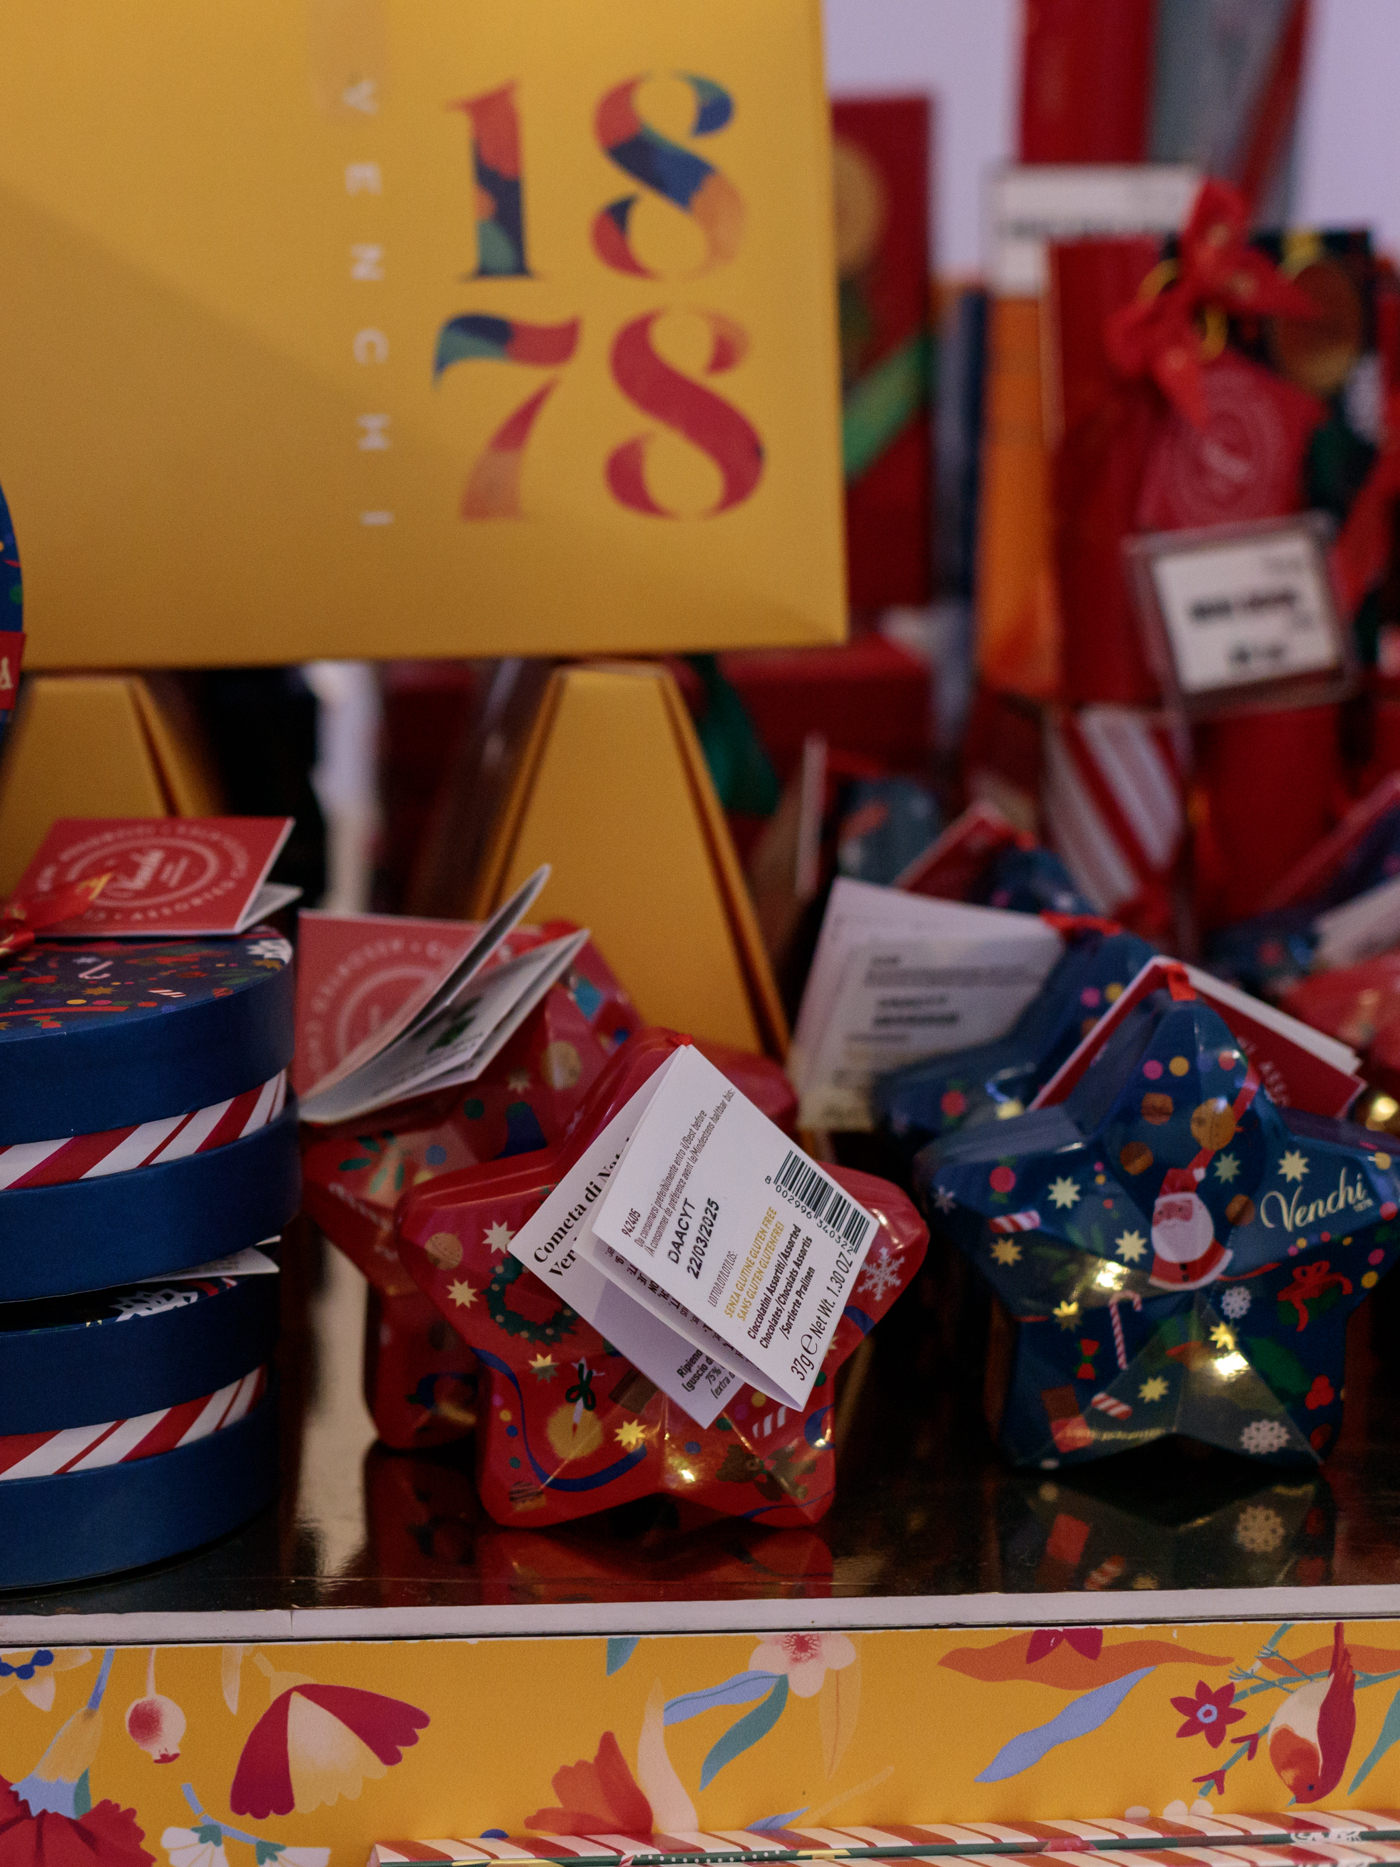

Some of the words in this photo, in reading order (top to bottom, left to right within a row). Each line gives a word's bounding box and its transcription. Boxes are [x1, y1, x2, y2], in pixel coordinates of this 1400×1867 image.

[446, 70, 747, 283] 18
[432, 305, 765, 523] 78
[640, 1203, 659, 1239] consumarsi
[673, 1148, 686, 1166] entro
[690, 1109, 707, 1131] before
[650, 1215, 669, 1249] consommer
[681, 1161, 694, 1180] avant
[709, 1099, 727, 1124] haltbar
[1260, 1166, 1367, 1232] Venchi
[534, 1203, 587, 1263] Cometa
[584, 1181, 602, 1203] di
[621, 1207, 641, 1237] 942405
[667, 1197, 695, 1264] DAACYT
[677, 1198, 719, 1279] 22/03/2025
[724, 1291, 741, 1318] SENZA
[735, 1256, 755, 1292] GLUTINE
[749, 1226, 767, 1258] GLUTEN
[761, 1206, 777, 1229] FREE
[835, 1251, 853, 1274] OZ
[736, 1297, 752, 1321] SANS
[746, 1267, 764, 1299] GLUTEN
[759, 1221, 784, 1269] GLUTENFREI
[747, 1292, 772, 1339] Cioccolatini
[766, 1223, 801, 1296] Assortiti/Assorted
[759, 1268, 798, 1348] Chocolates/Chocolats
[792, 1235, 812, 1270] Assortis
[779, 1298, 802, 1340] /Sortierte
[795, 1266, 815, 1300] Pralinen
[817, 1298, 836, 1318] Wt.
[826, 1270, 845, 1297] 1.30
[790, 1353, 814, 1381] 37g
[809, 1315, 827, 1339] Net
